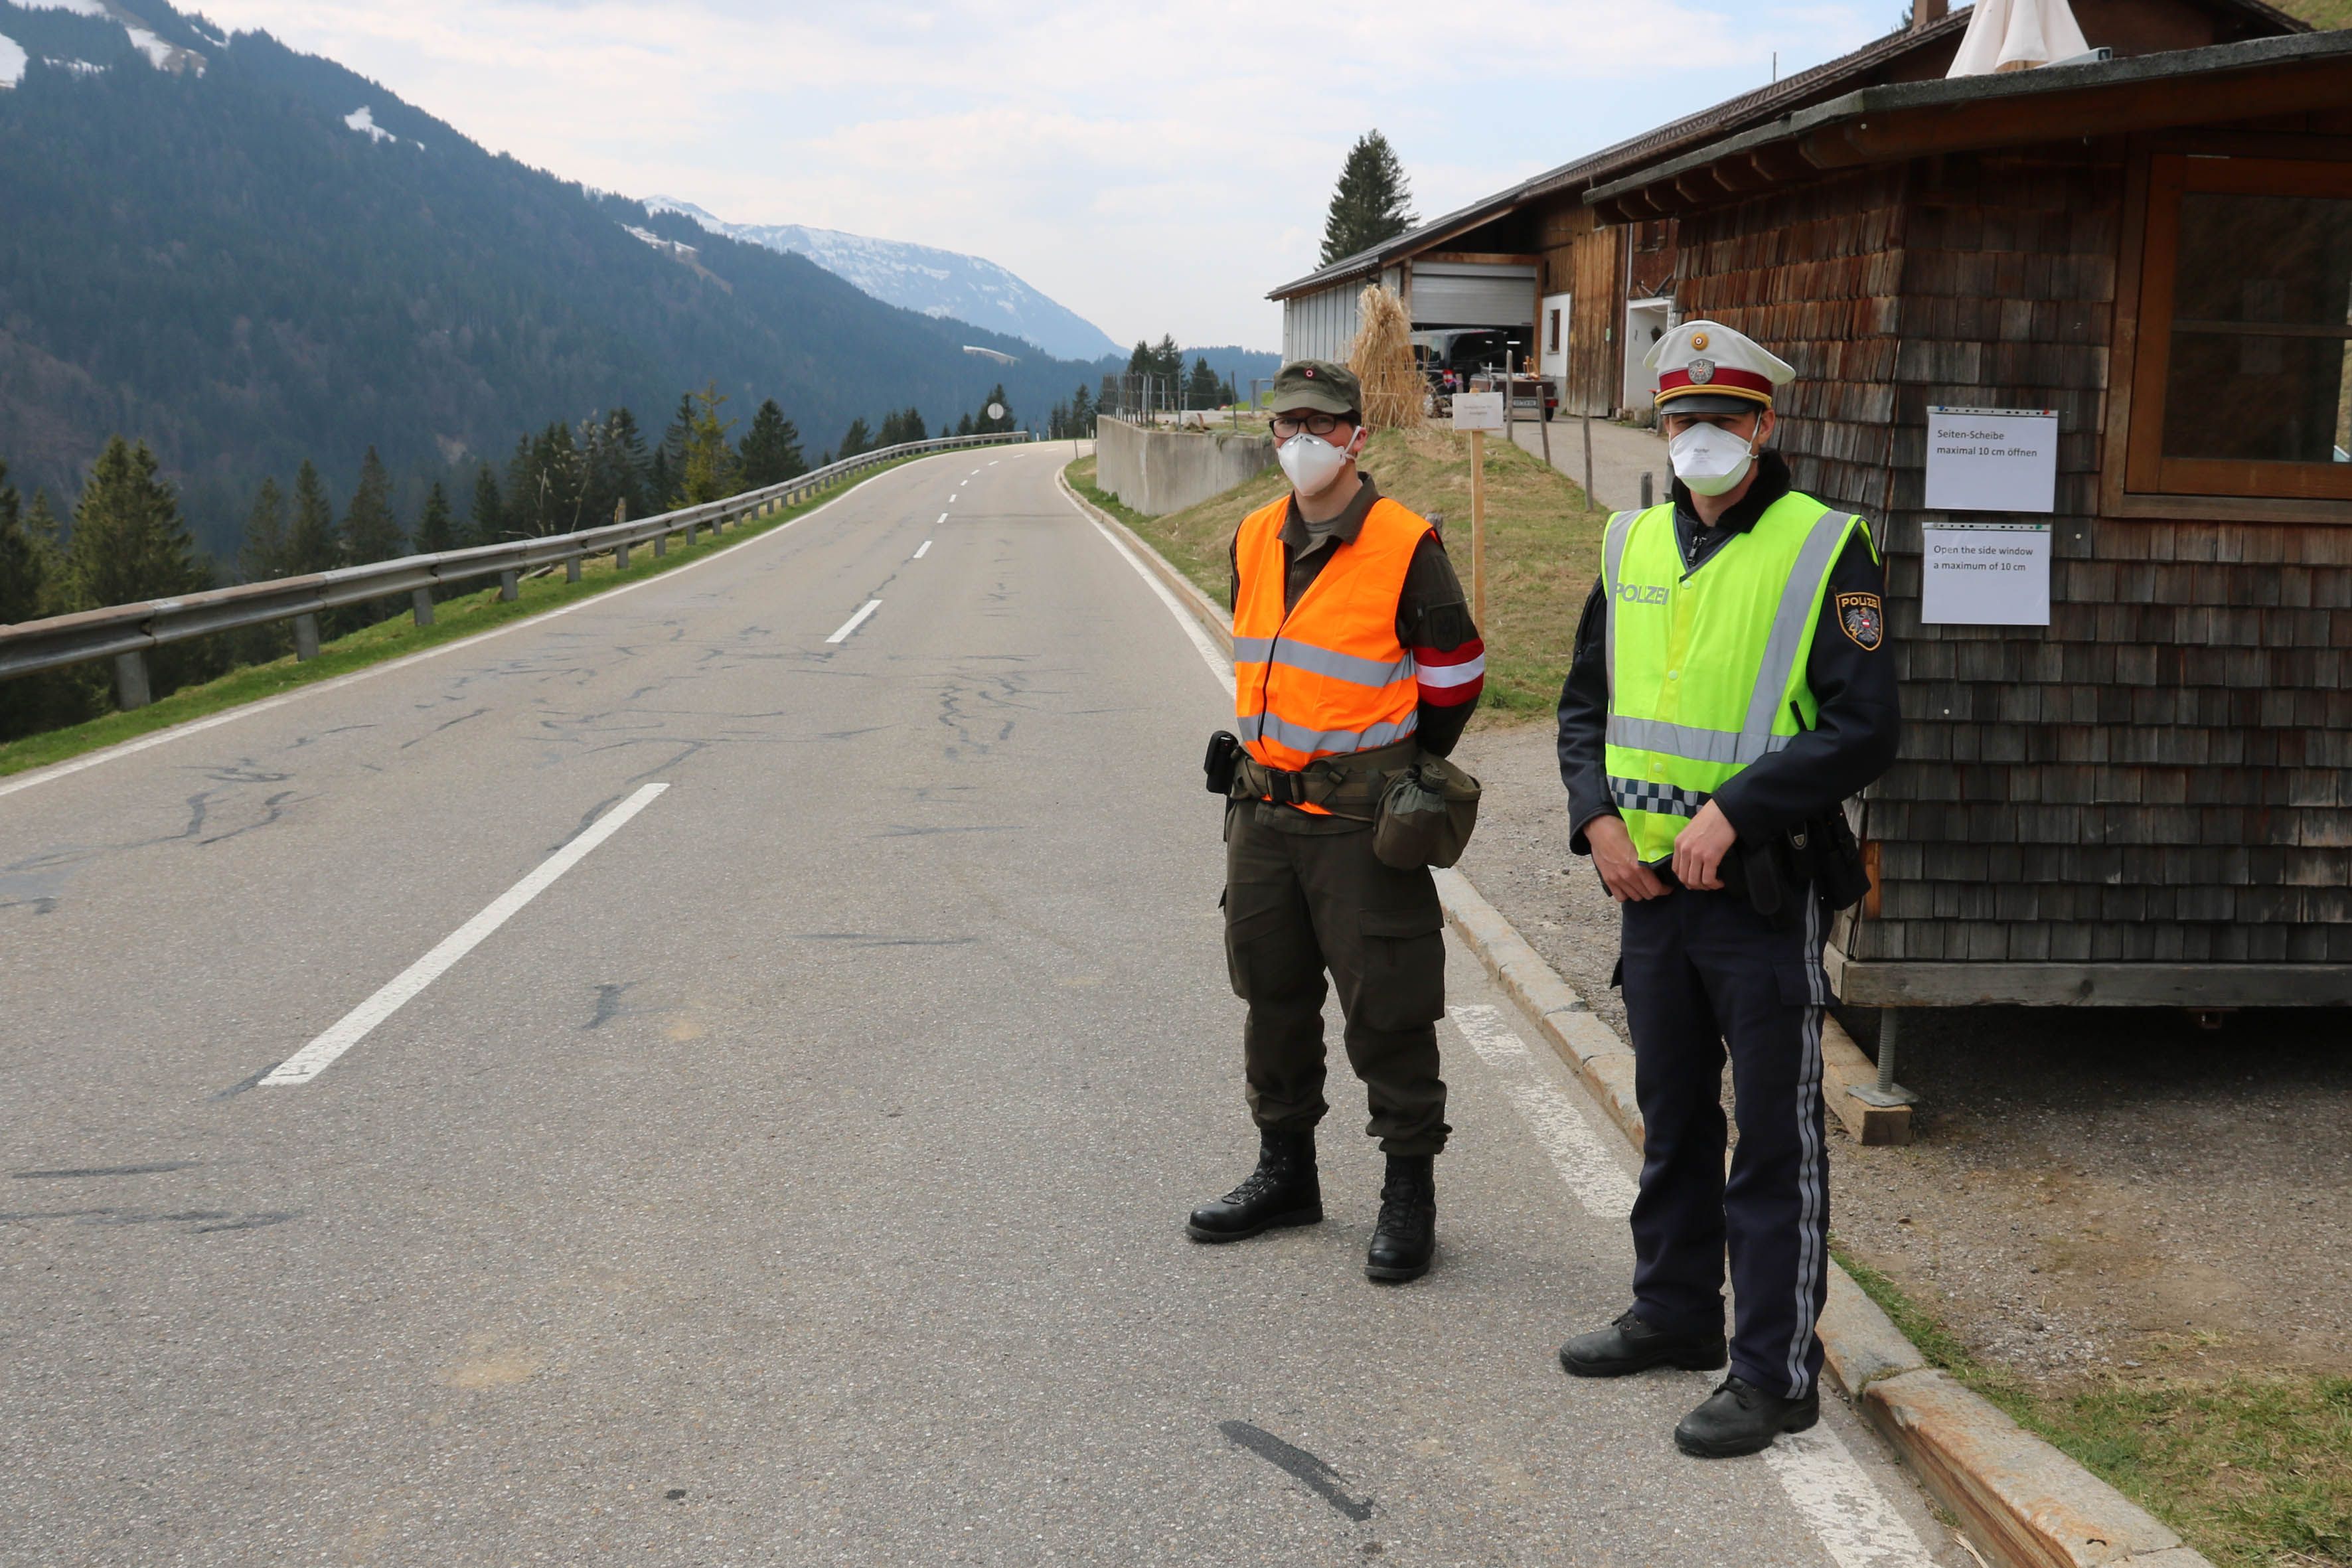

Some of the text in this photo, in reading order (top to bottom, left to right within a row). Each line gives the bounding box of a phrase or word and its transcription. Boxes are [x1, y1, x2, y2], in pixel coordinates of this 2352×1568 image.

[1937, 430, 2005, 440] Seiten-Scheibe
[1936, 446, 1976, 455] maximal
[2007, 447, 2037, 457] öffnen
[1933, 545, 2033, 556] Open the side window
[1942, 562, 1987, 570] maximum
[1989, 562, 1998, 570] of
